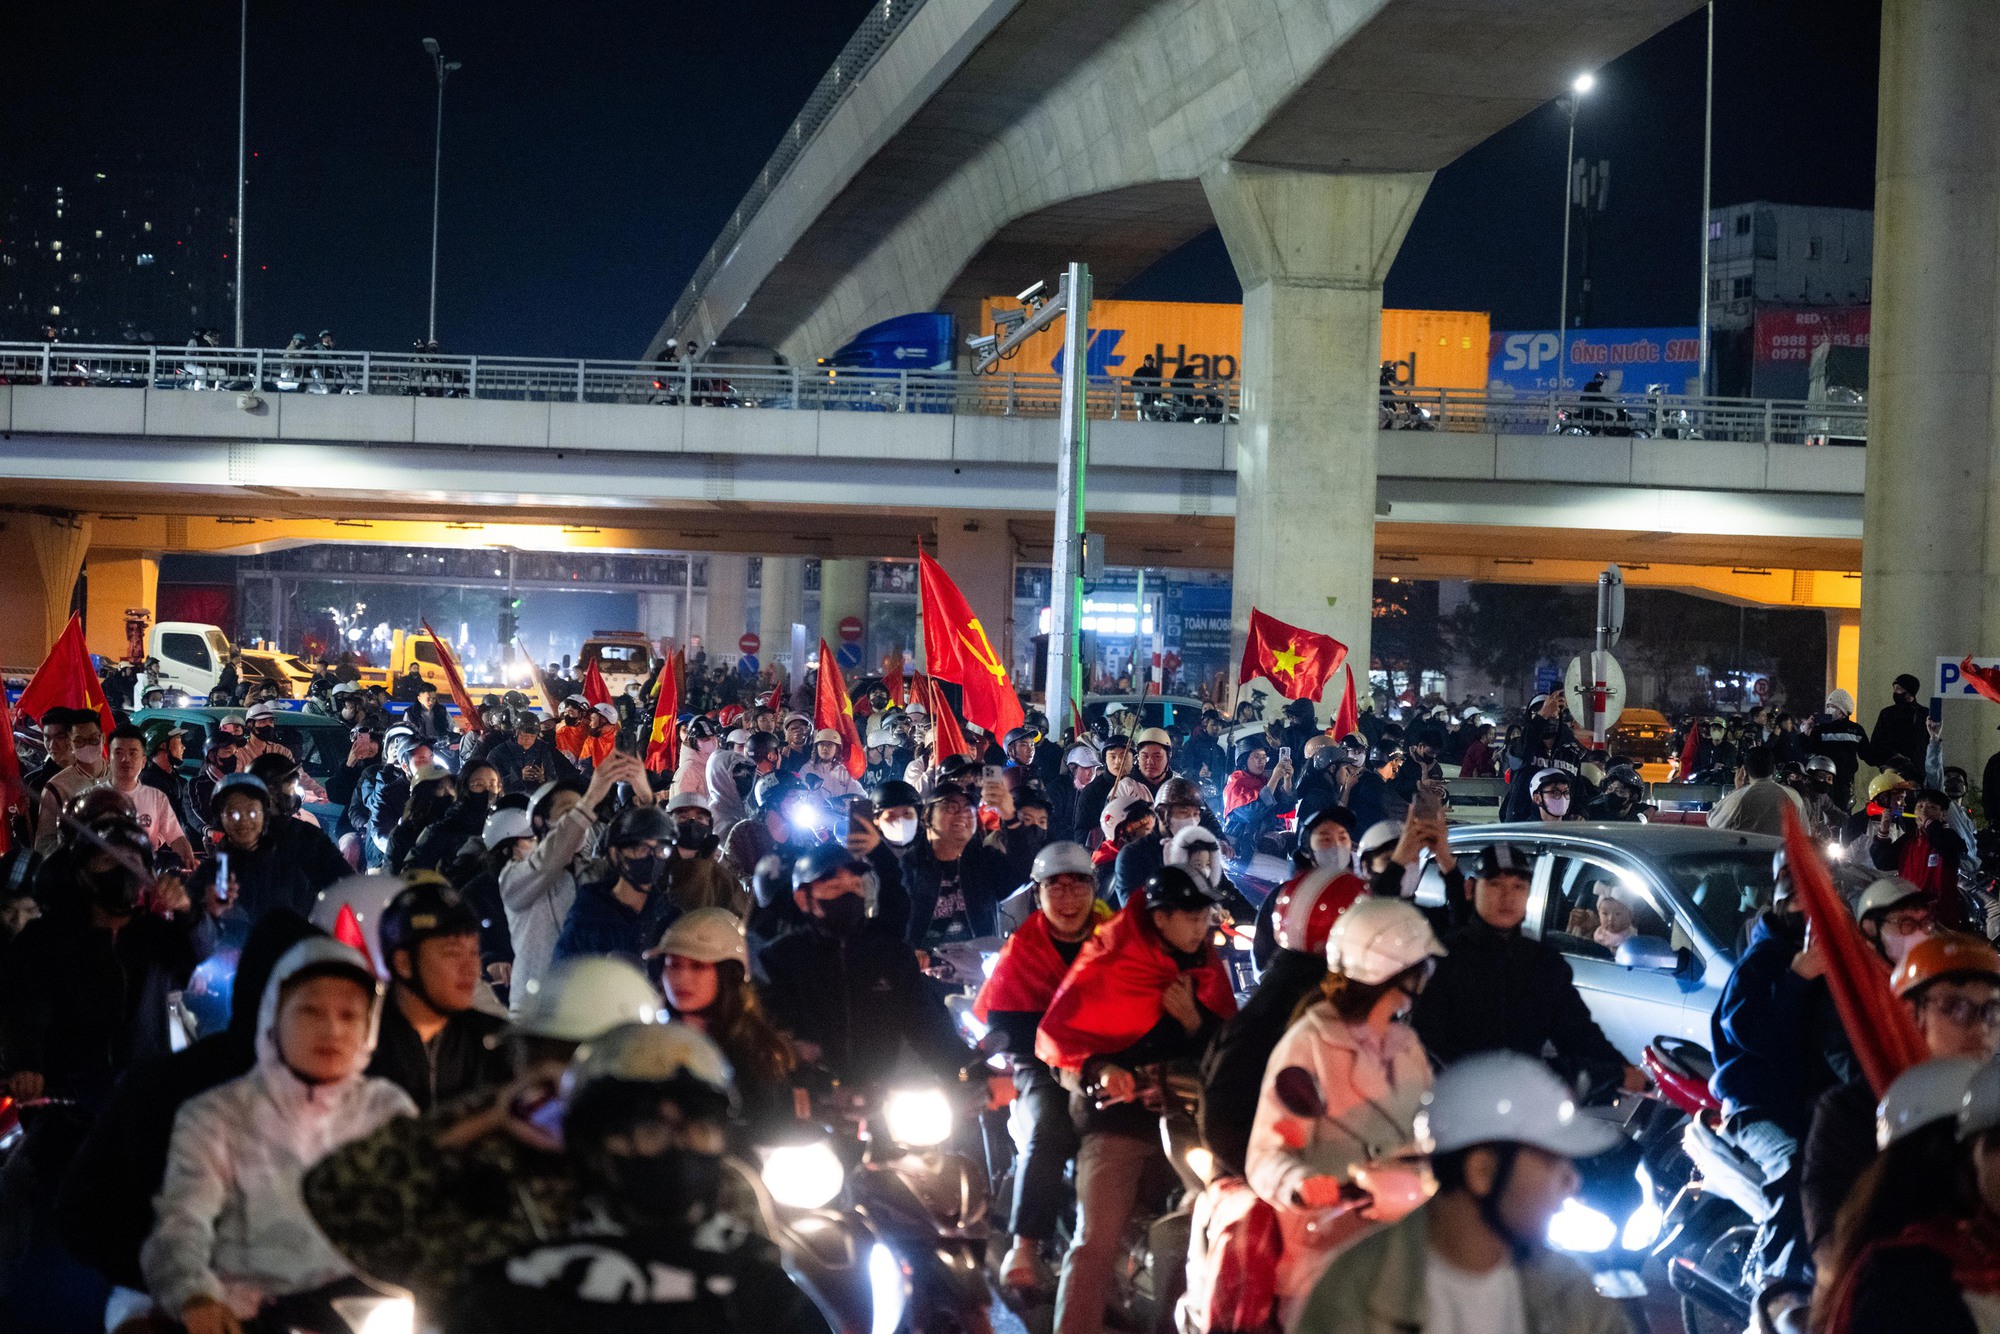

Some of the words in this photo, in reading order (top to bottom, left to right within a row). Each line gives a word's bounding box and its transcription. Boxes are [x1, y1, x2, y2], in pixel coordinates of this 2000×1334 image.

[1156, 343, 1241, 380] Hap
[1504, 334, 1560, 371] SP
[1664, 339, 1706, 362] SIN
